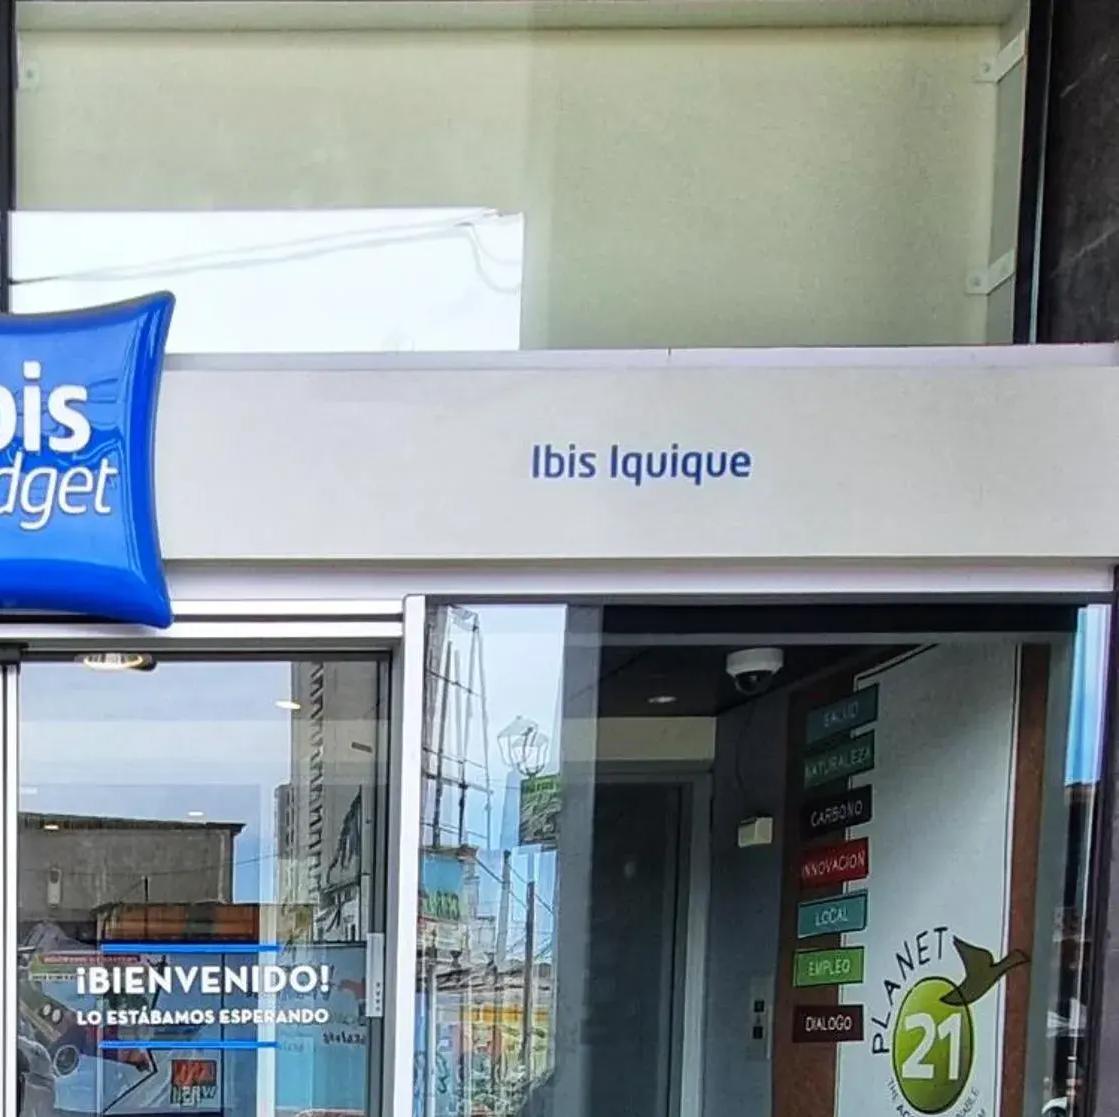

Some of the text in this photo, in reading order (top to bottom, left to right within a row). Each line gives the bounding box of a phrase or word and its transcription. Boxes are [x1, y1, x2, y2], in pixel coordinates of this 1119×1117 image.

[532, 443, 752, 486] Ibis Iquique
[810, 800, 863, 827] CARBONO
[815, 907, 849, 927] LOCAL
[77, 964, 330, 995] ¡BIENVENIDO!
[808, 959, 851, 977] EMPLEO
[871, 926, 962, 1080] PLANET 21
[77, 1005, 330, 1026] LO ESTÁBAMOS ESPERANDO
[805, 1016, 853, 1032] DIALOGO
